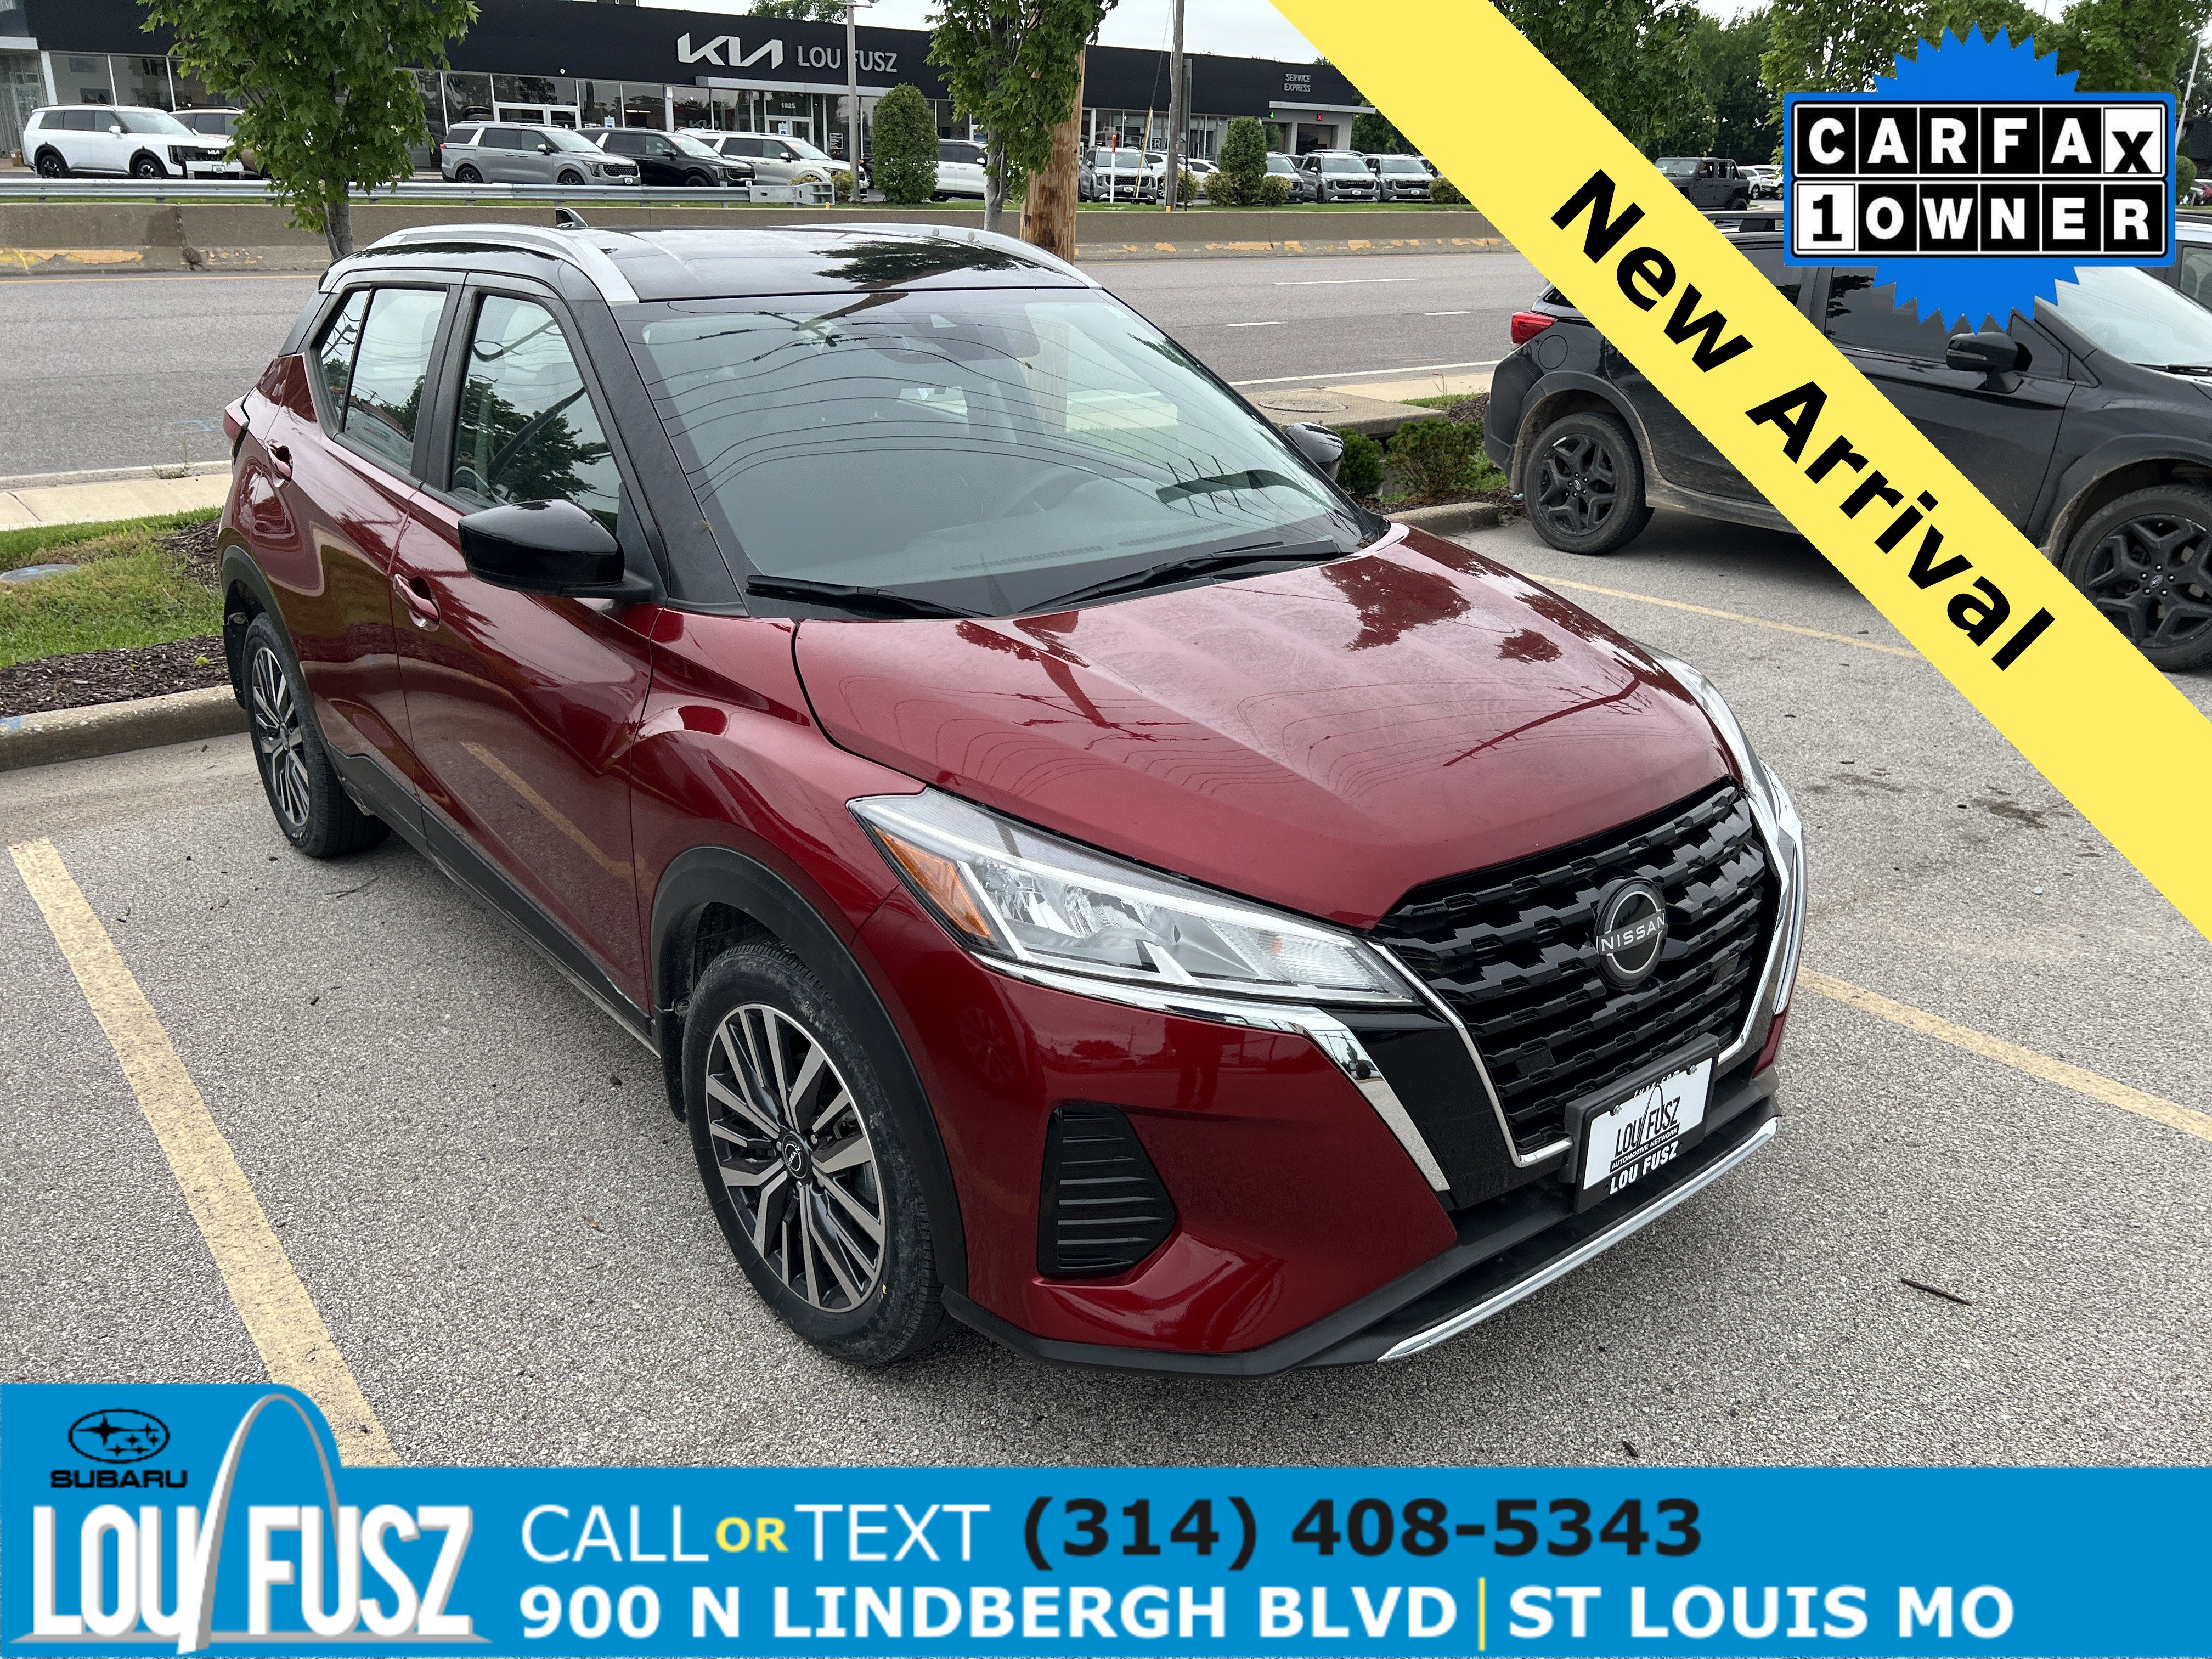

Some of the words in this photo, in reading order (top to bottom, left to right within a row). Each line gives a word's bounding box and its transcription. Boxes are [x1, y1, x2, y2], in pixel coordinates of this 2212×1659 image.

[797, 46, 842, 69] LOU
[1283, 83, 1311, 93] EXPRESS
[1285, 74, 1311, 83] SERVICE
[1601, 913, 1665, 952] NISSAN
[1615, 1117, 1643, 1158] LOU
[1645, 1096, 1681, 1141] FUSZ
[1610, 1163, 1639, 1195] LOU
[1642, 1140, 1679, 1176] FUSZ
[1611, 1144, 1649, 1170] AUTOMOTIVE
[1650, 1127, 1678, 1147] NETWORK
